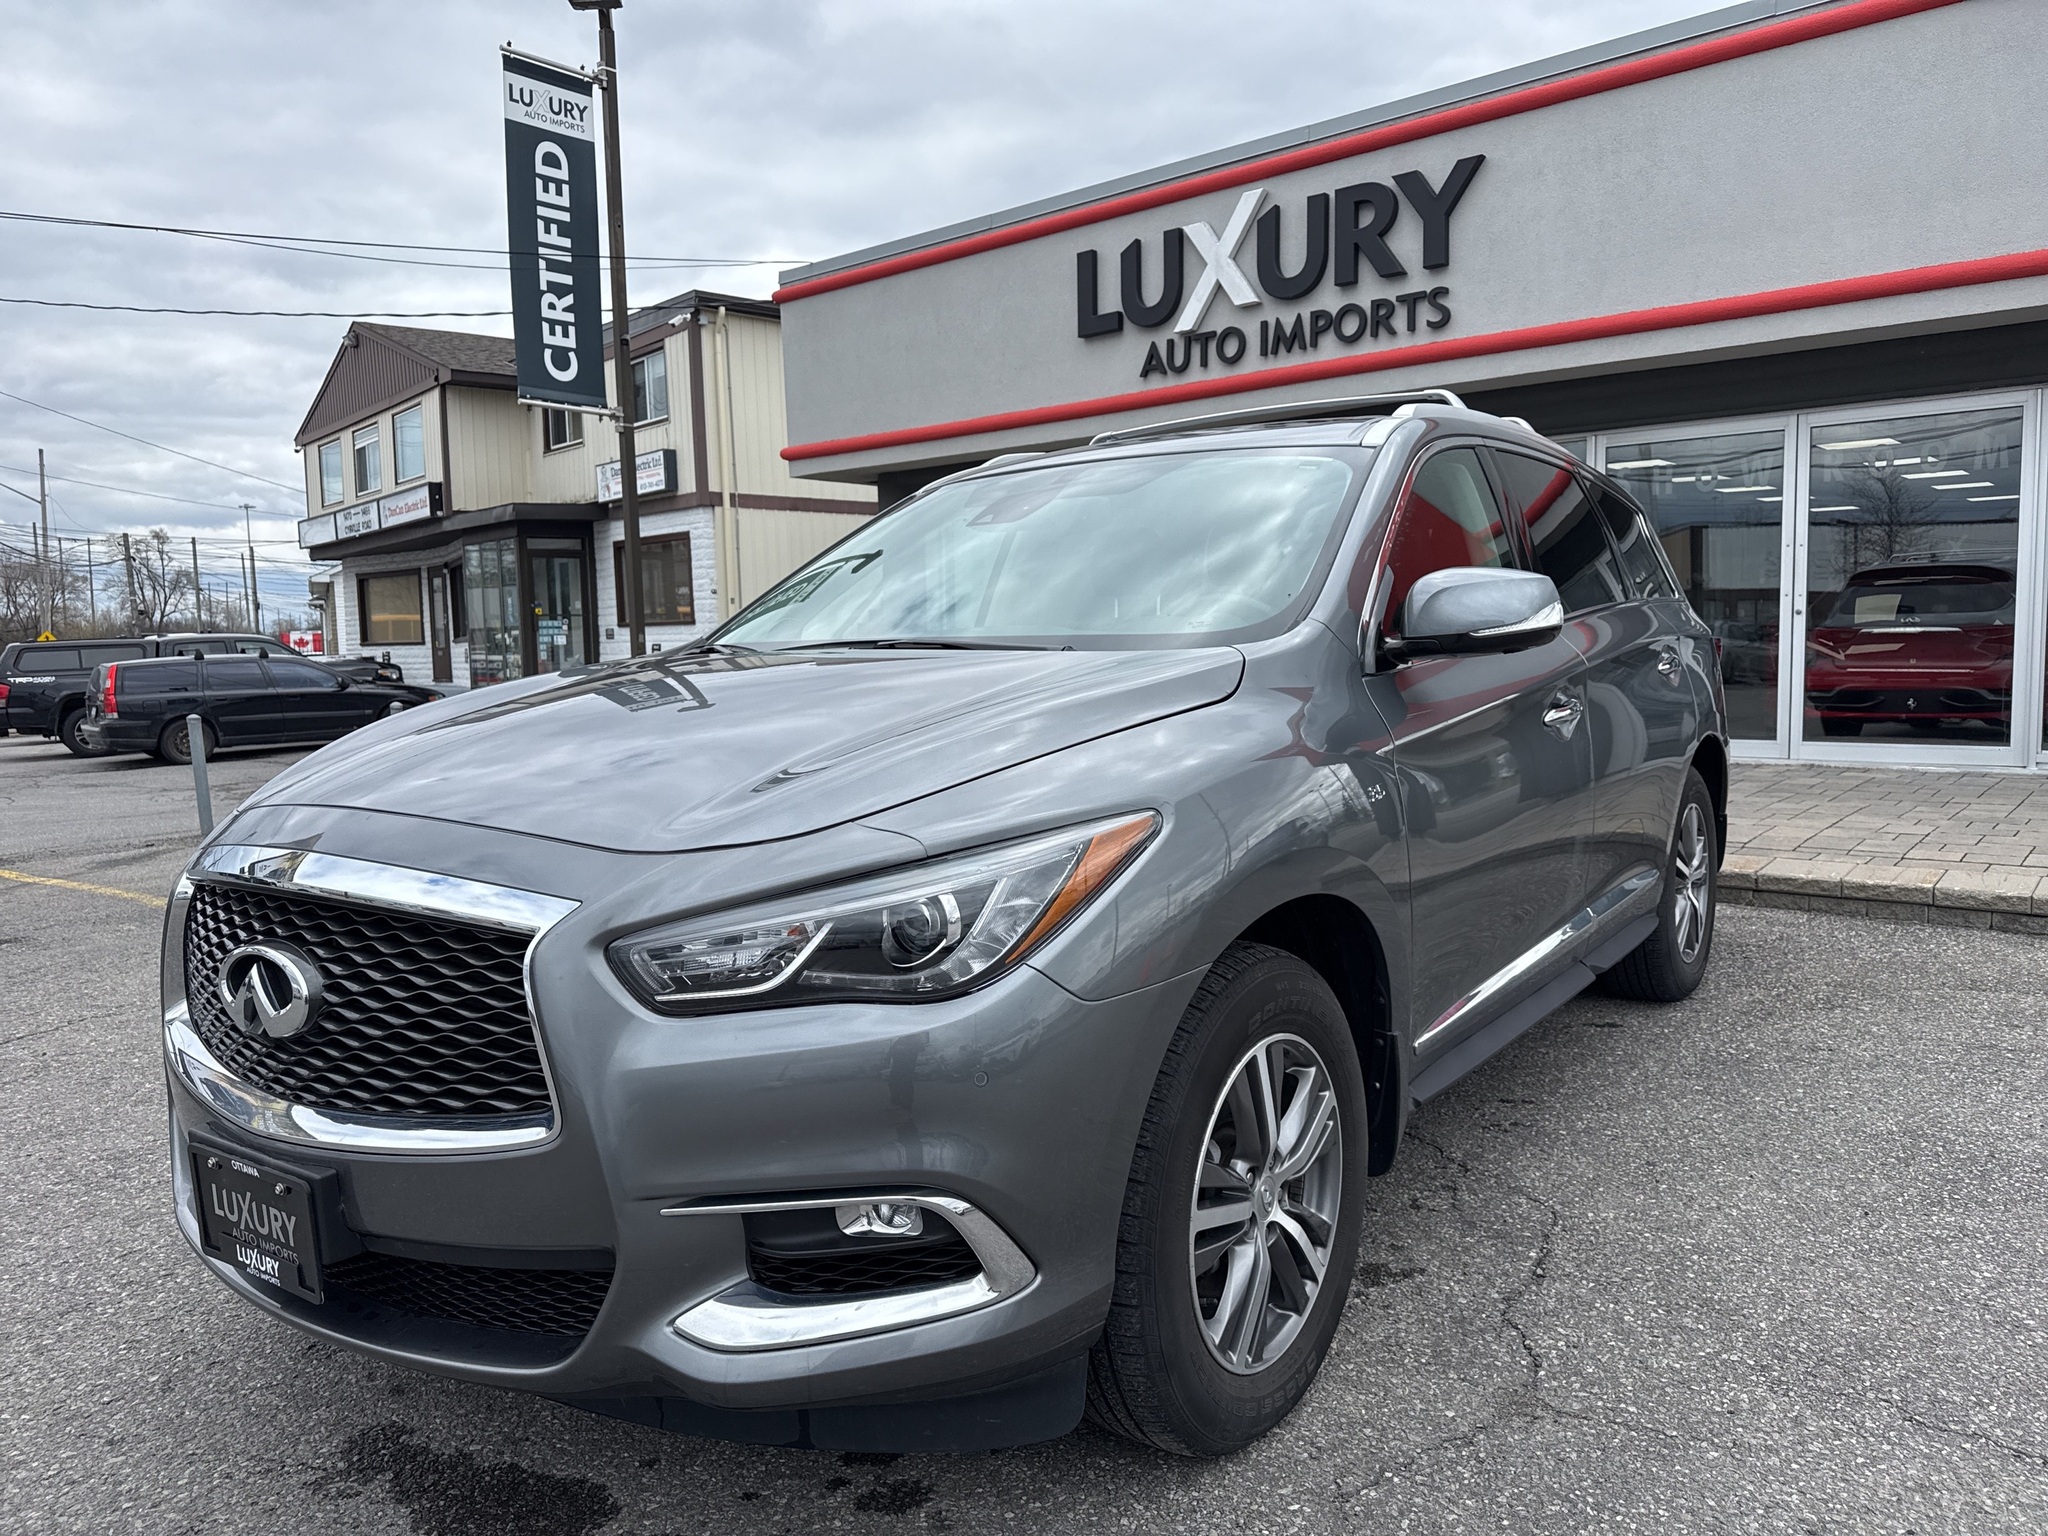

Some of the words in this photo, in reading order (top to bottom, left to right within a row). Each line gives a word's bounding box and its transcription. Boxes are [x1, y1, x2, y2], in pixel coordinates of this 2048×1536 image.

[509, 82, 588, 123] LUXURY
[524, 109, 547, 123] AUTO
[549, 117, 585, 133] IMPORTS
[535, 140, 578, 382] CERTIFIED
[1077, 154, 1486, 339] LUXURY
[1139, 326, 1246, 377] AUTO
[1259, 287, 1451, 357] IMPORTS
[231, 1159, 260, 1178] OTTAWA
[211, 1183, 296, 1247] LUXURY
[232, 1227, 258, 1246] AUTO
[259, 1237, 299, 1265] IMPORTS
[236, 1244, 280, 1277] LUXURY
[246, 1267, 260, 1277] AUTO
[260, 1273, 281, 1286] IMPORTS
